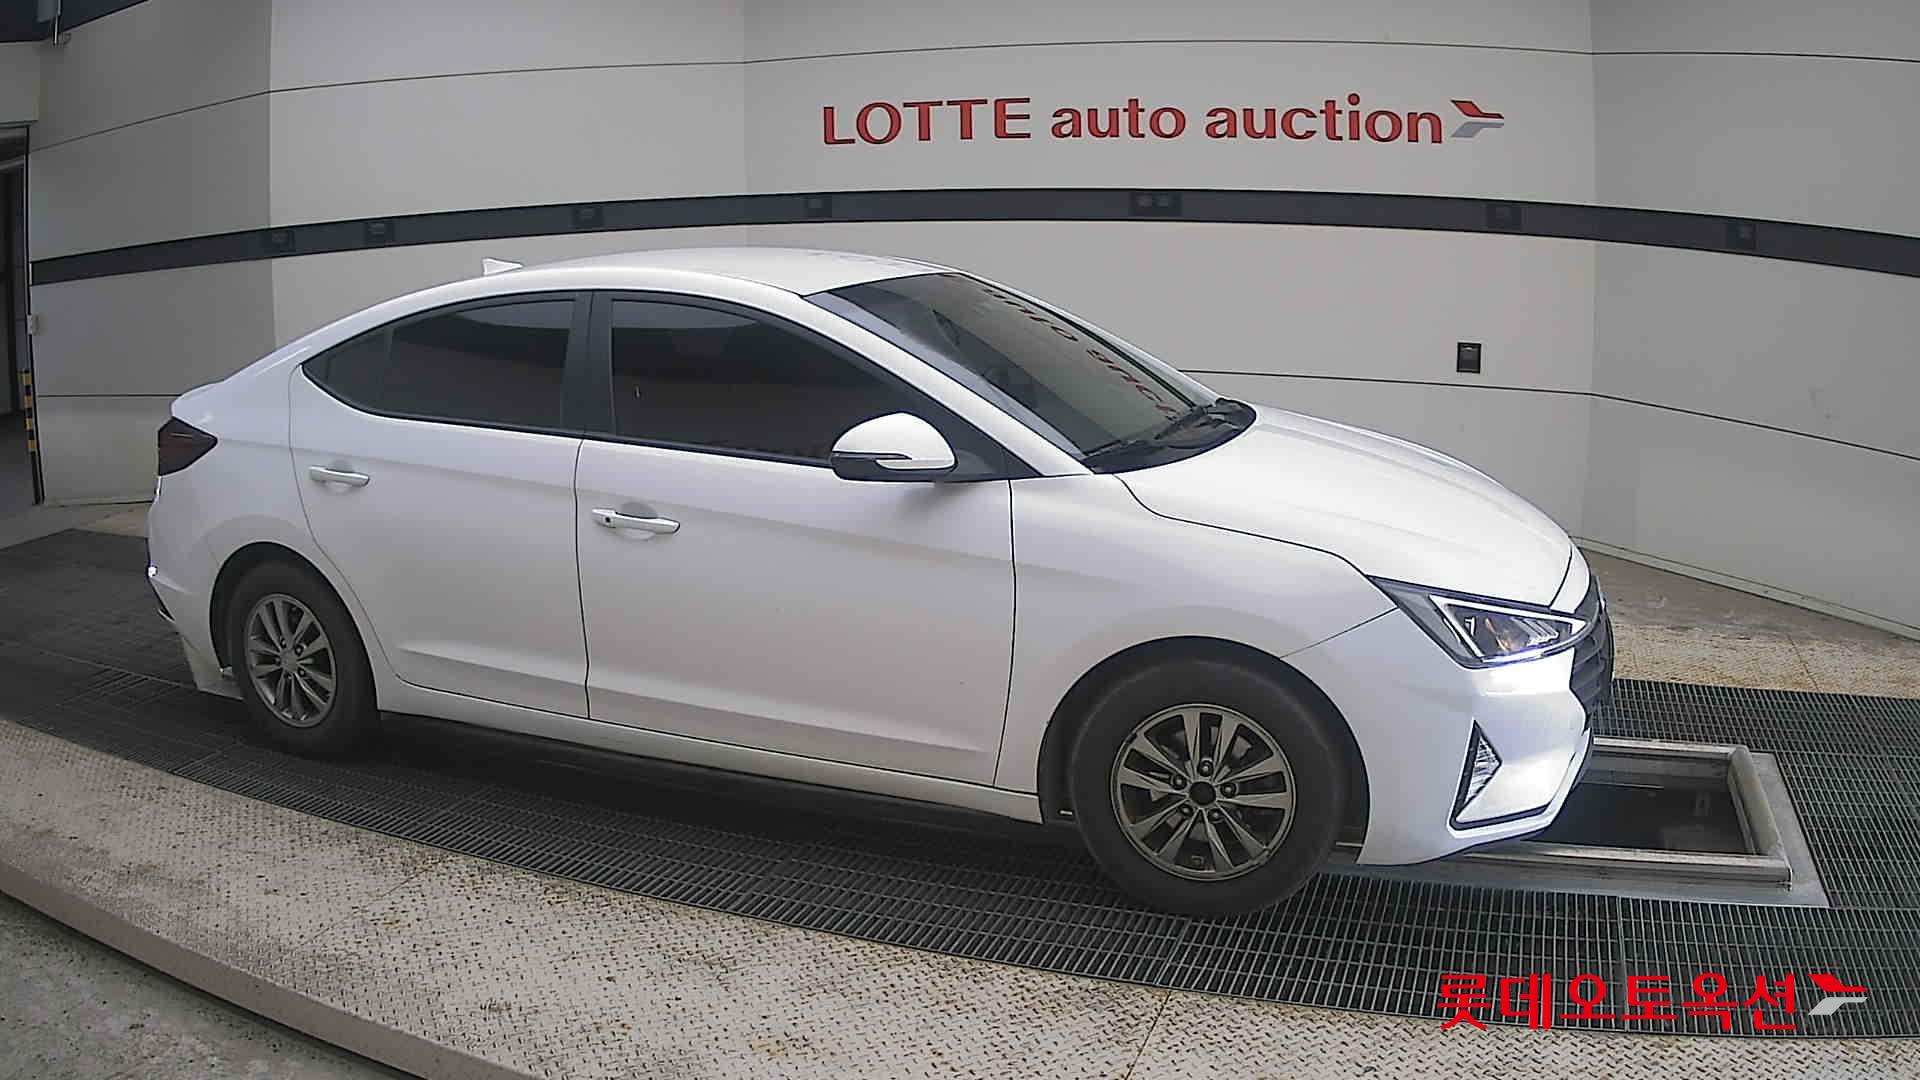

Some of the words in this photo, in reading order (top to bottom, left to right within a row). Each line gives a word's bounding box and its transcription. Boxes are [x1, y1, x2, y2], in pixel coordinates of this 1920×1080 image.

[823, 97, 1031, 146] LOTTE
[1051, 98, 1186, 139] auto
[1205, 93, 1443, 144] auction
